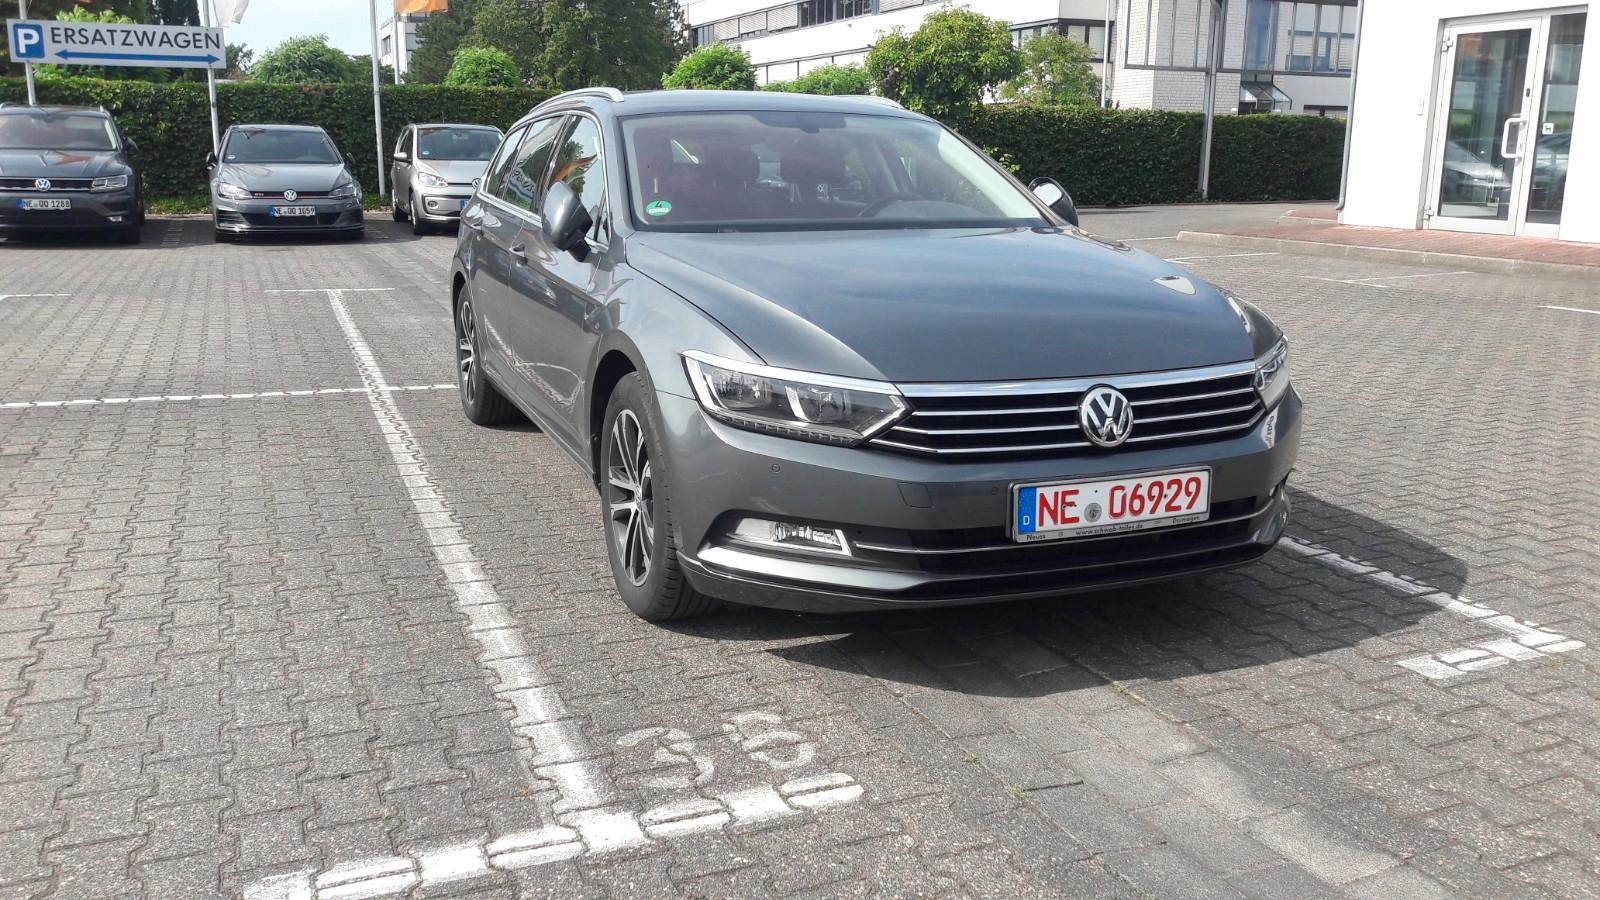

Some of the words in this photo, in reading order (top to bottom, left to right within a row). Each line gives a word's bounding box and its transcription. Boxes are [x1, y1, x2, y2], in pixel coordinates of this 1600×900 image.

[17, 28, 40, 53] P
[51, 26, 221, 49] ERSATZWAGEN
[23, 200, 33, 208] NE
[274, 207, 283, 215] NE
[299, 207, 315, 215] 1059
[1023, 515, 1030, 526] D
[1038, 489, 1080, 527] NE
[1108, 476, 1202, 520] 06929
